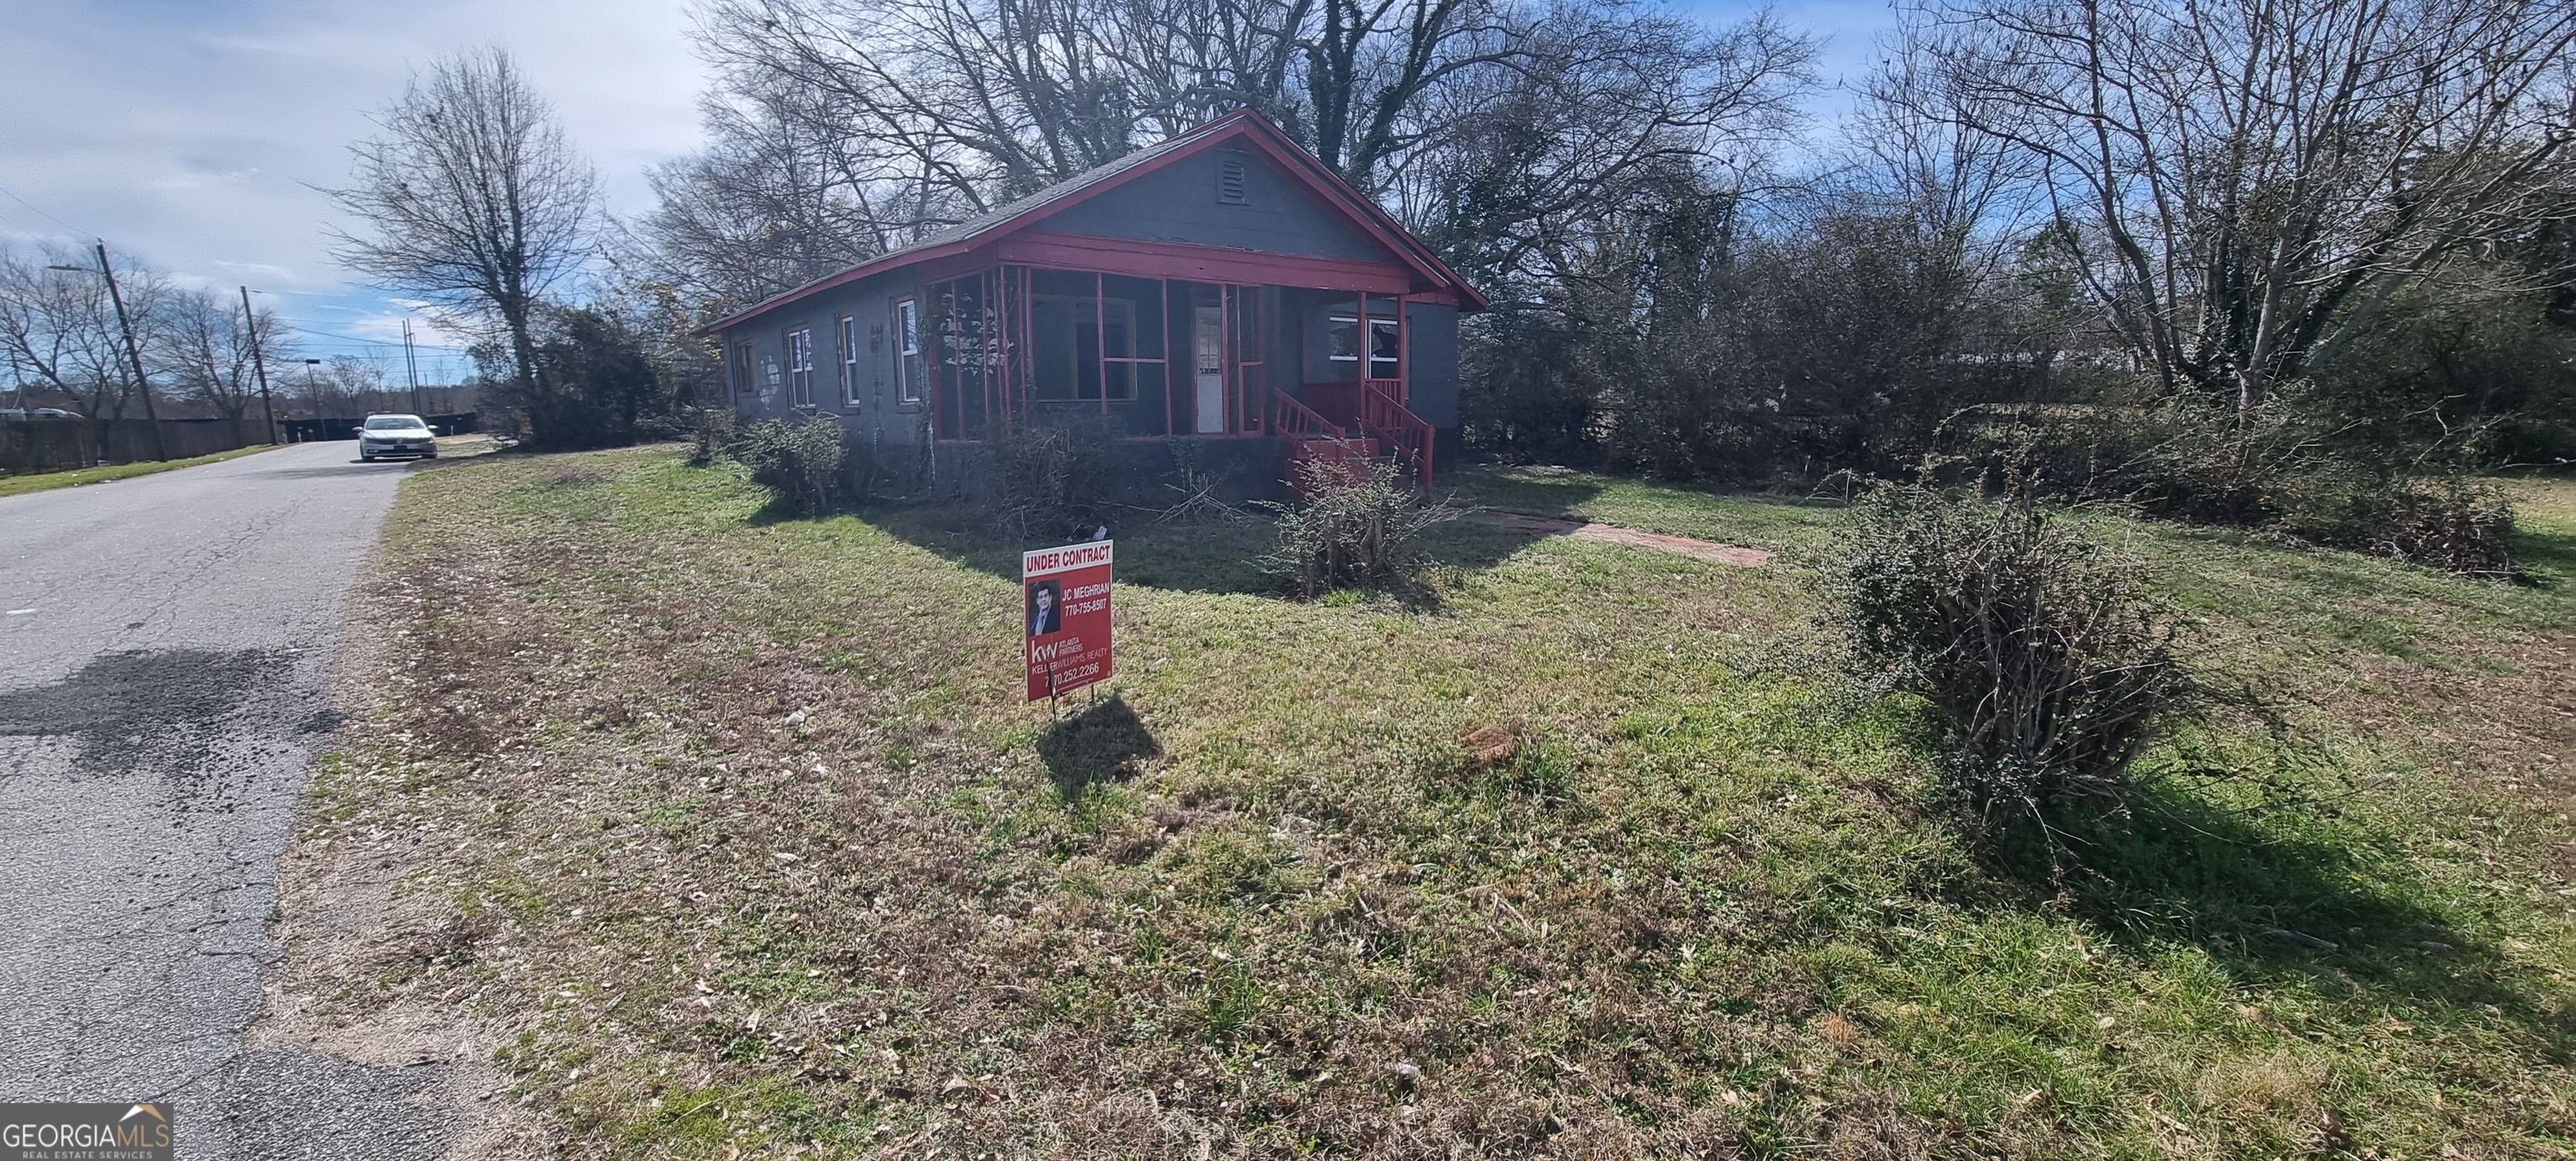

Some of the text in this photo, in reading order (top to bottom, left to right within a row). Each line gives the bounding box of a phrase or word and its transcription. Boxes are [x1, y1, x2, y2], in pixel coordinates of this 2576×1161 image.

[1026, 545, 1110, 572] UNDER CONTRACT
[1062, 582, 1109, 601] JC MEGHRIAN
[1058, 637, 1080, 649] ATLANTA
[1059, 643, 1083, 656] PARTNERS
[1031, 640, 1057, 664] kw
[1087, 648, 1108, 660] REALTY
